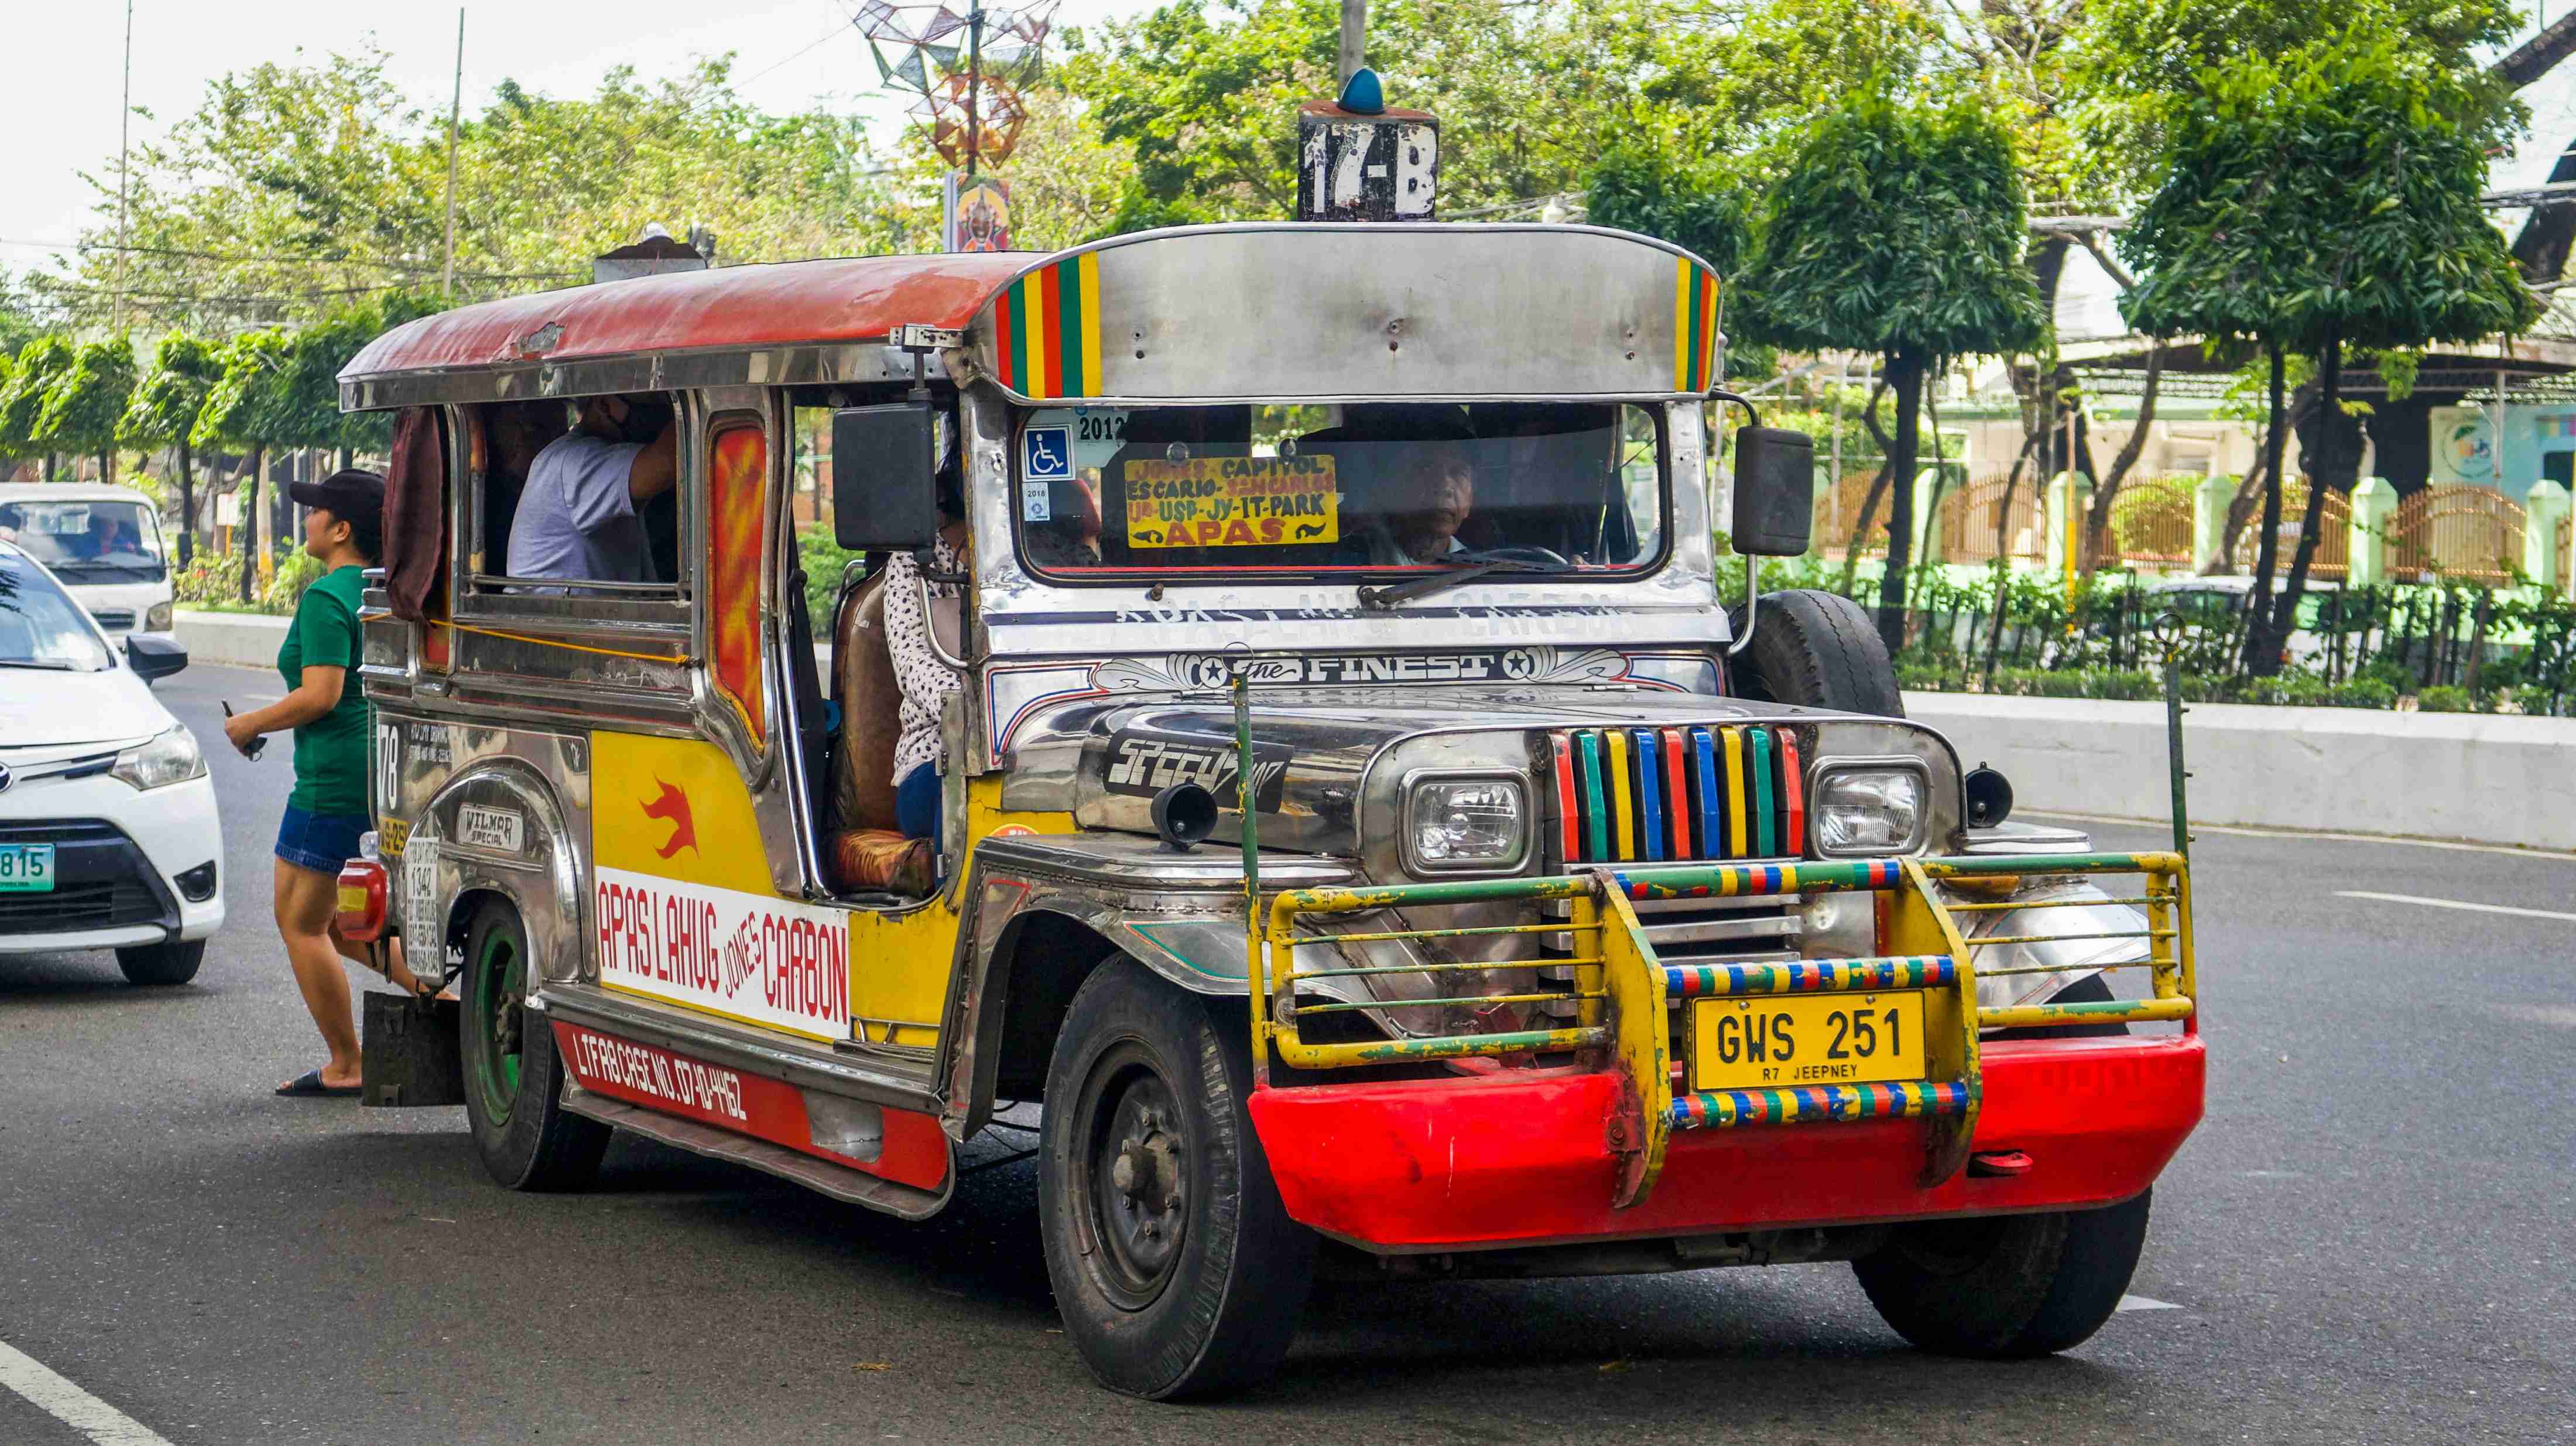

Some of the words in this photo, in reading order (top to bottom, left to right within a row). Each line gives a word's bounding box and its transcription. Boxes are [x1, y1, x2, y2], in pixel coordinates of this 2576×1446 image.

[1304, 123, 1437, 214] 17-B
[1221, 458, 1326, 478] CAPITOL
[1164, 518, 1286, 546] APAS
[1308, 656, 1495, 681] FINEST
[466, 811, 512, 845] WILMAR
[471, 830, 502, 846] SPECIAL
[1, 852, 43, 877] 815
[412, 867, 431, 897] 1342
[598, 882, 651, 977] APAS
[653, 892, 719, 993] LAHUG
[724, 911, 761, 1000] JONES
[762, 913, 847, 1025] CARBON
[1718, 1013, 1795, 1064] GWS
[1826, 1008, 1900, 1059] 251
[617, 1042, 657, 1095] CASE
[1763, 1067, 1780, 1082] R7
[1793, 1064, 1858, 1081] JEEPNEY
